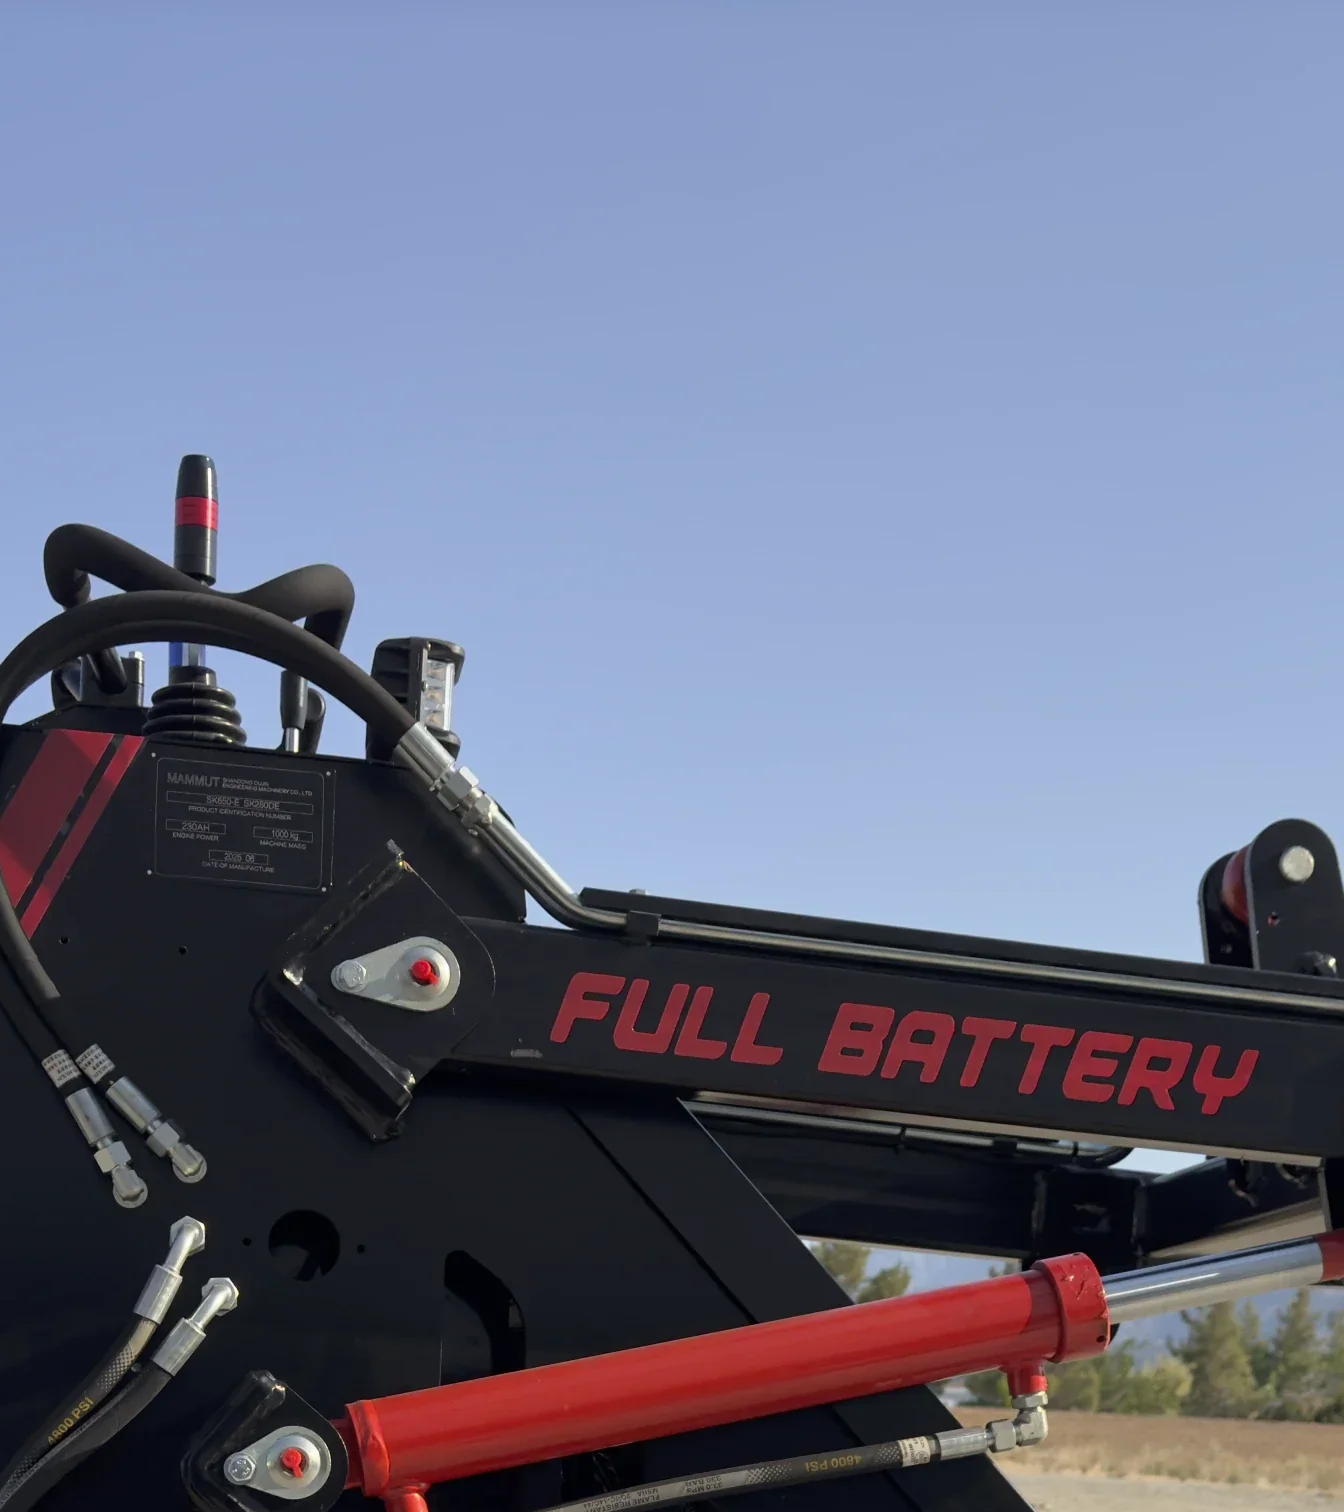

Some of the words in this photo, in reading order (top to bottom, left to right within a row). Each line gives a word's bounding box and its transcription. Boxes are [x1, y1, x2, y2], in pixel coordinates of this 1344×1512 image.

[167, 772, 220, 788] MAMMUT
[222, 783, 258, 791] ENGINEERING
[258, 786, 290, 795] MACHINERY
[206, 795, 239, 806] SK650-E
[188, 805, 217, 814] PRODUCT
[218, 808, 265, 818] IDENTIFICATION
[265, 813, 292, 821] NUMBER
[271, 829, 288, 838] 1000
[289, 831, 299, 841] kg
[259, 840, 287, 848] MACHINE
[224, 852, 242, 862] 2025
[228, 863, 274, 873] MANUFACTURE
[550, 972, 784, 1066] FULL
[818, 1002, 1259, 1115] BATTERY
[47, 1417, 74, 1445] 4800
[71, 1396, 94, 1419] PSI
[805, 1460, 829, 1472] PSI
[685, 1478, 704, 1487] BAR
[636, 1488, 659, 1497] MSHA
[632, 1494, 660, 1505] FLAME
